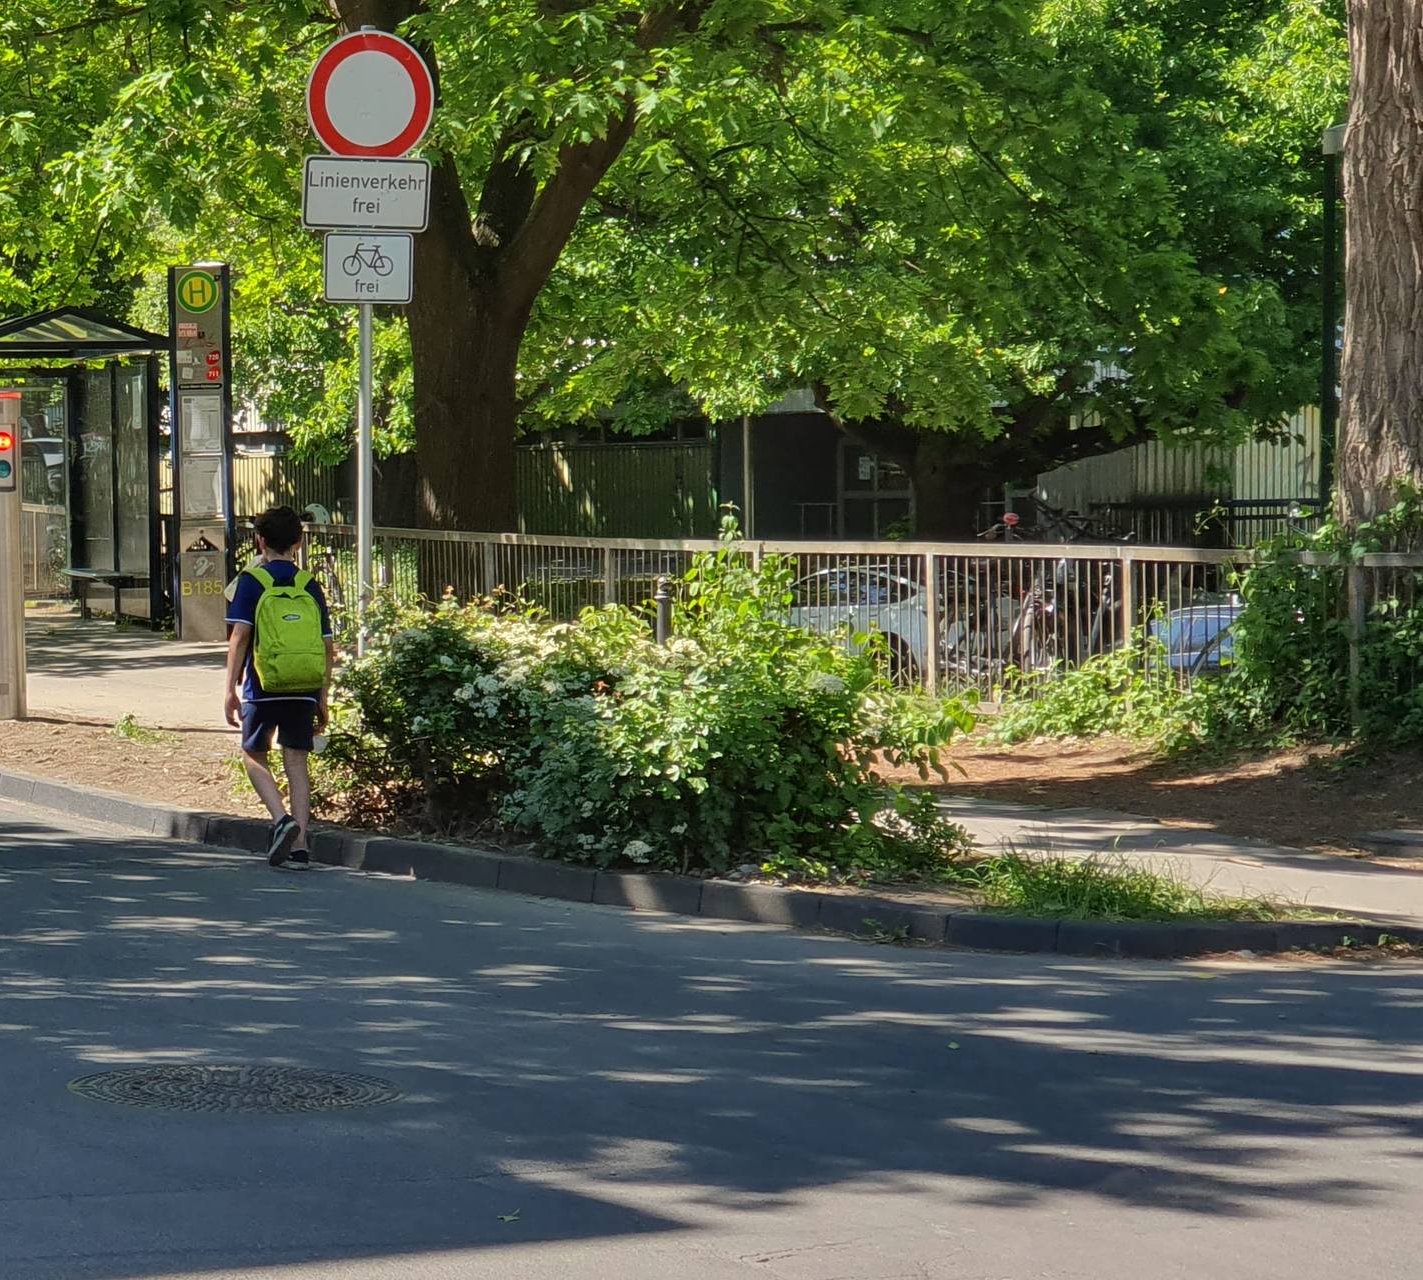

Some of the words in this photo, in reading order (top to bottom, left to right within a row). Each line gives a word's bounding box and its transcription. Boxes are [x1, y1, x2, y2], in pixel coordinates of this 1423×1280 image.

[309, 171, 425, 190] Linienverkehr
[353, 197, 380, 213] frei
[189, 280, 206, 304] H
[355, 278, 379, 293] frei
[181, 580, 224, 596] B185
